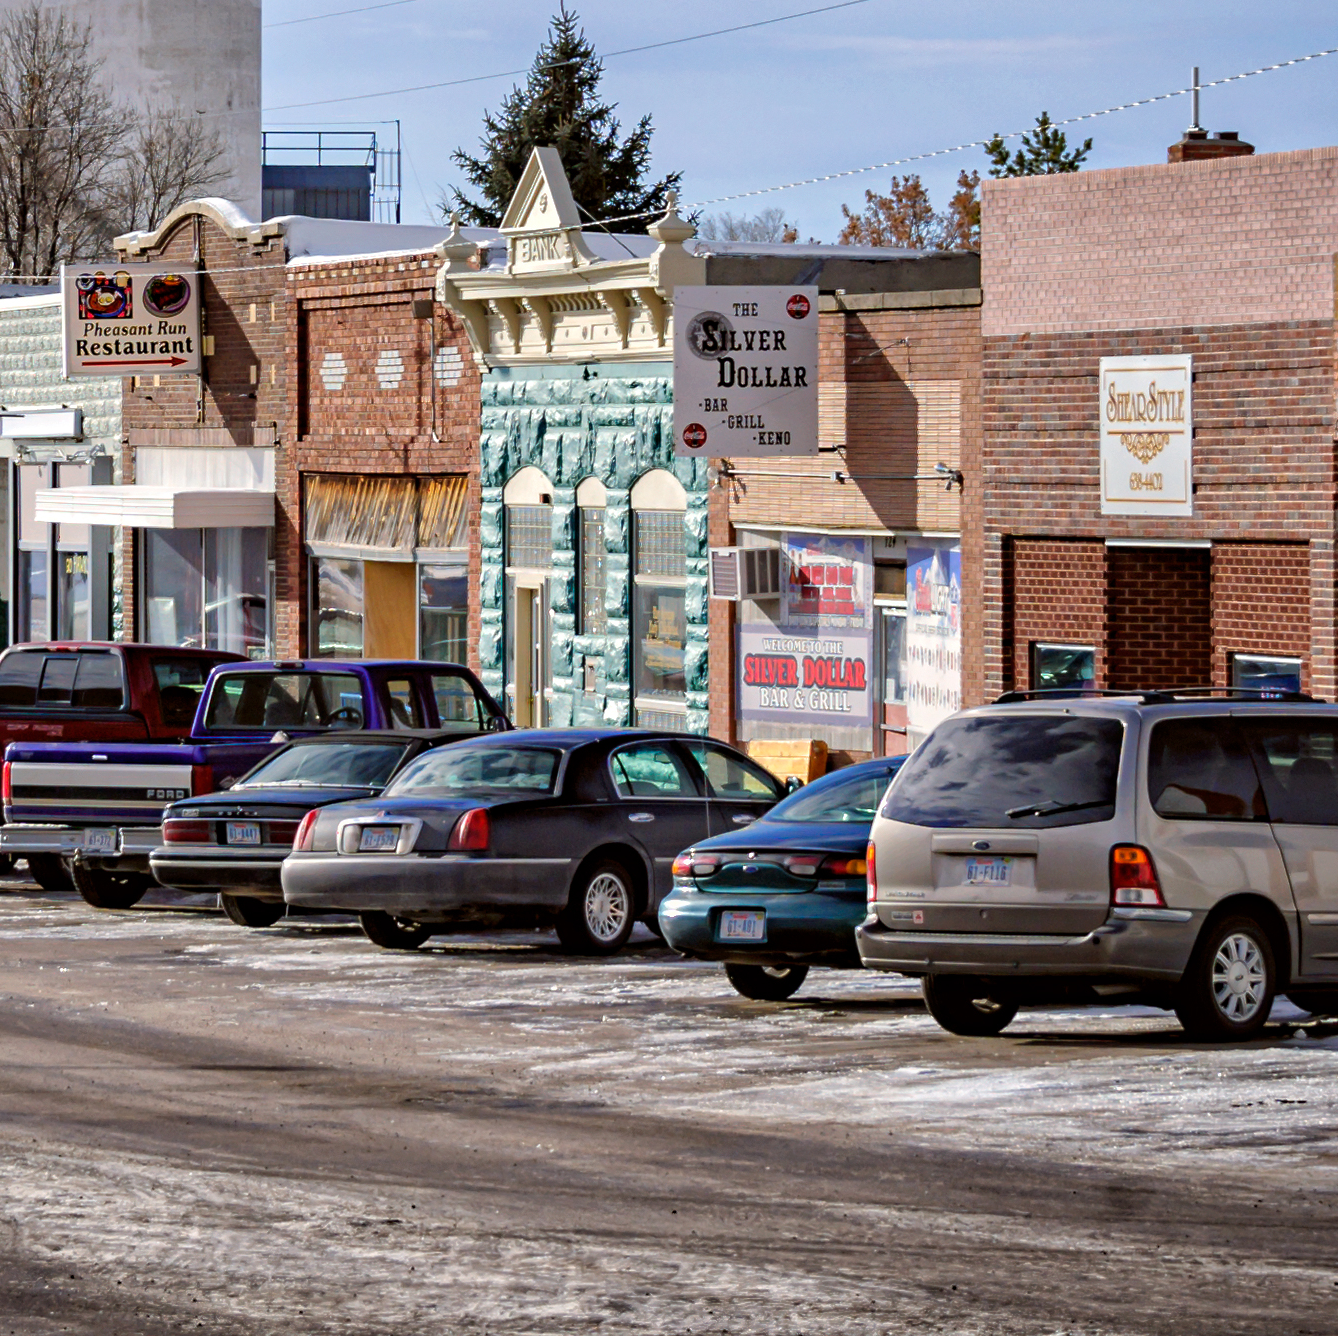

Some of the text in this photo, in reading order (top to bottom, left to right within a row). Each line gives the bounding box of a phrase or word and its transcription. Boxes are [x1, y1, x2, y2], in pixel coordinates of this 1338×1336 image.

[522, 235, 561, 262] BANK
[732, 302, 759, 317] THE
[83, 320, 187, 337] Pheasant Run
[702, 319, 787, 352] SILVER
[76, 336, 194, 357] Restaurant
[717, 356, 808, 388] DOLLAR
[704, 398, 728, 412] BAR
[727, 414, 765, 429] GRILL
[758, 431, 791, 445] KENO
[762, 638, 843, 654] WELCOME TO THE
[743, 653, 867, 691] SILVER DOLLAR
[760, 686, 851, 712] BAR & GRILL
[146, 789, 185, 799] FORD
